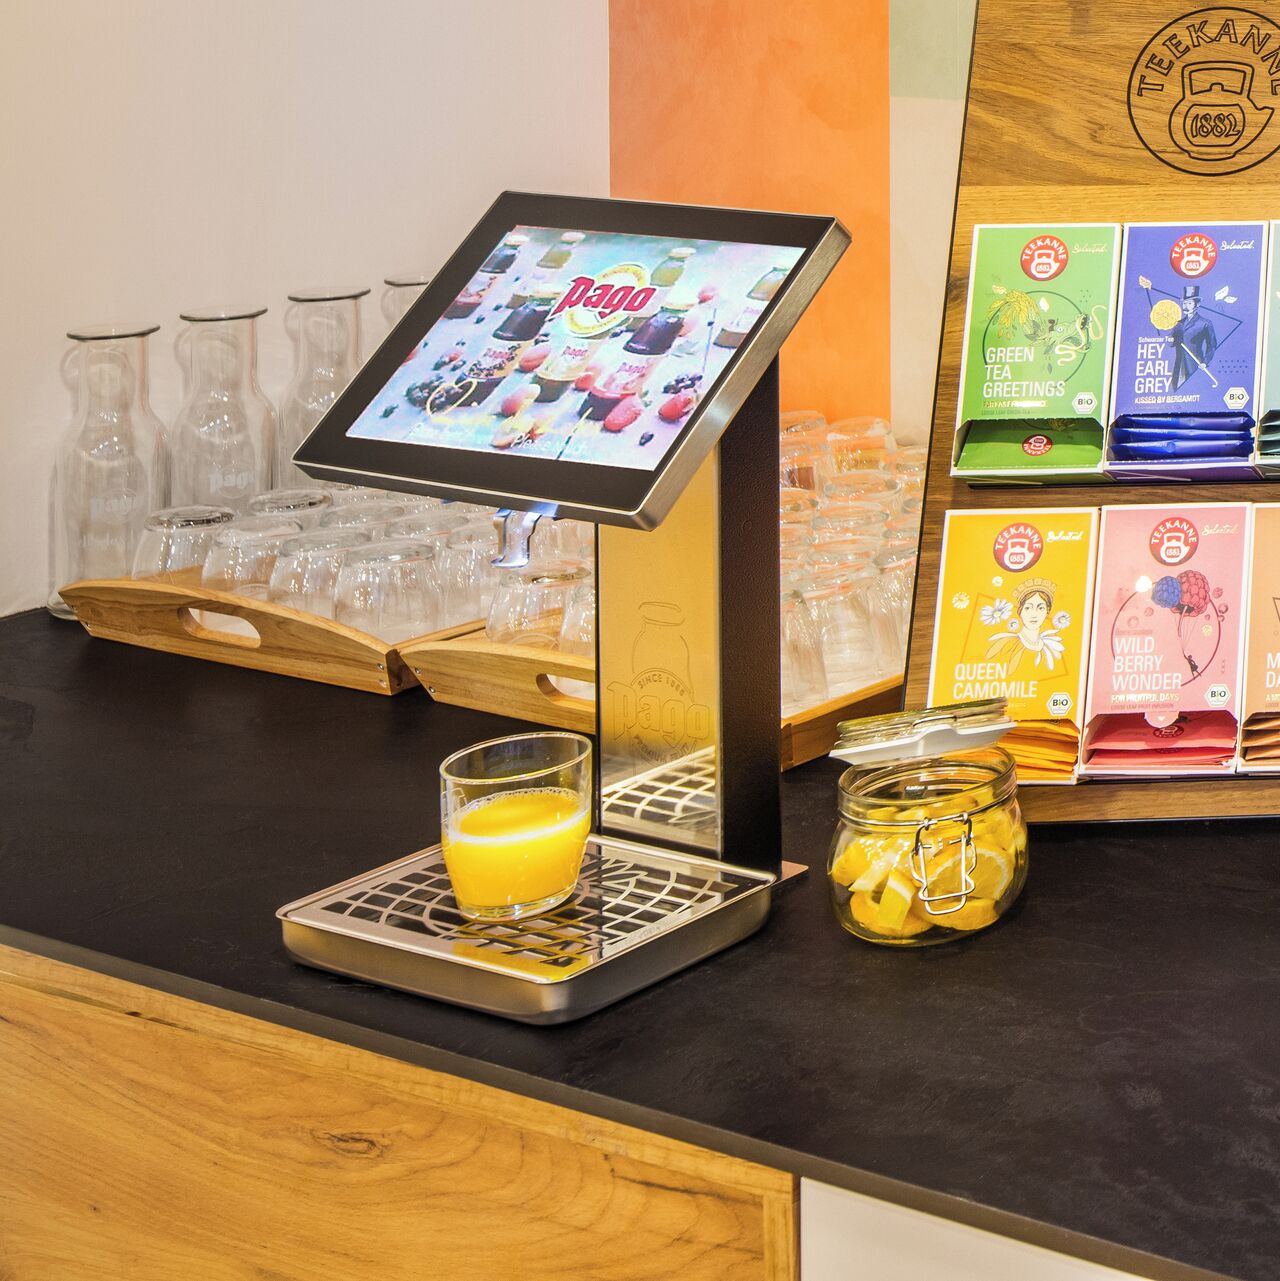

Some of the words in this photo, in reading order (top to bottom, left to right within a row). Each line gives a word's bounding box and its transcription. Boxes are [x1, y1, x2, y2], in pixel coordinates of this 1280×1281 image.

[1190, 112, 1241, 139] 1882
[1022, 238, 1067, 261] TEEKANNE
[1171, 236, 1216, 259] TEEKANNE
[549, 275, 657, 320] pago
[985, 347, 1035, 365] GREEN
[1137, 343, 1165, 360] HEY
[984, 365, 1012, 381] TEA
[1135, 360, 1172, 376] EARL
[982, 381, 1066, 399] GREETINGS
[1134, 377, 1173, 393] GREY
[1166, 394, 1201, 403] BERGAMOT
[994, 525, 1042, 551] TEEKANNE
[1151, 519, 1197, 545] TEEKANNE
[1115, 636, 1155, 654] WILD
[954, 662, 1007, 681] QUEEN
[1113, 655, 1164, 673] BERRY
[638, 673, 662, 690] SINCE
[953, 680, 1038, 700] CAMOMILE
[1112, 673, 1182, 692] WONDER
[1111, 694, 1125, 703] FOR
[1160, 693, 1180, 701] DAYS
[606, 681, 710, 749] pago
